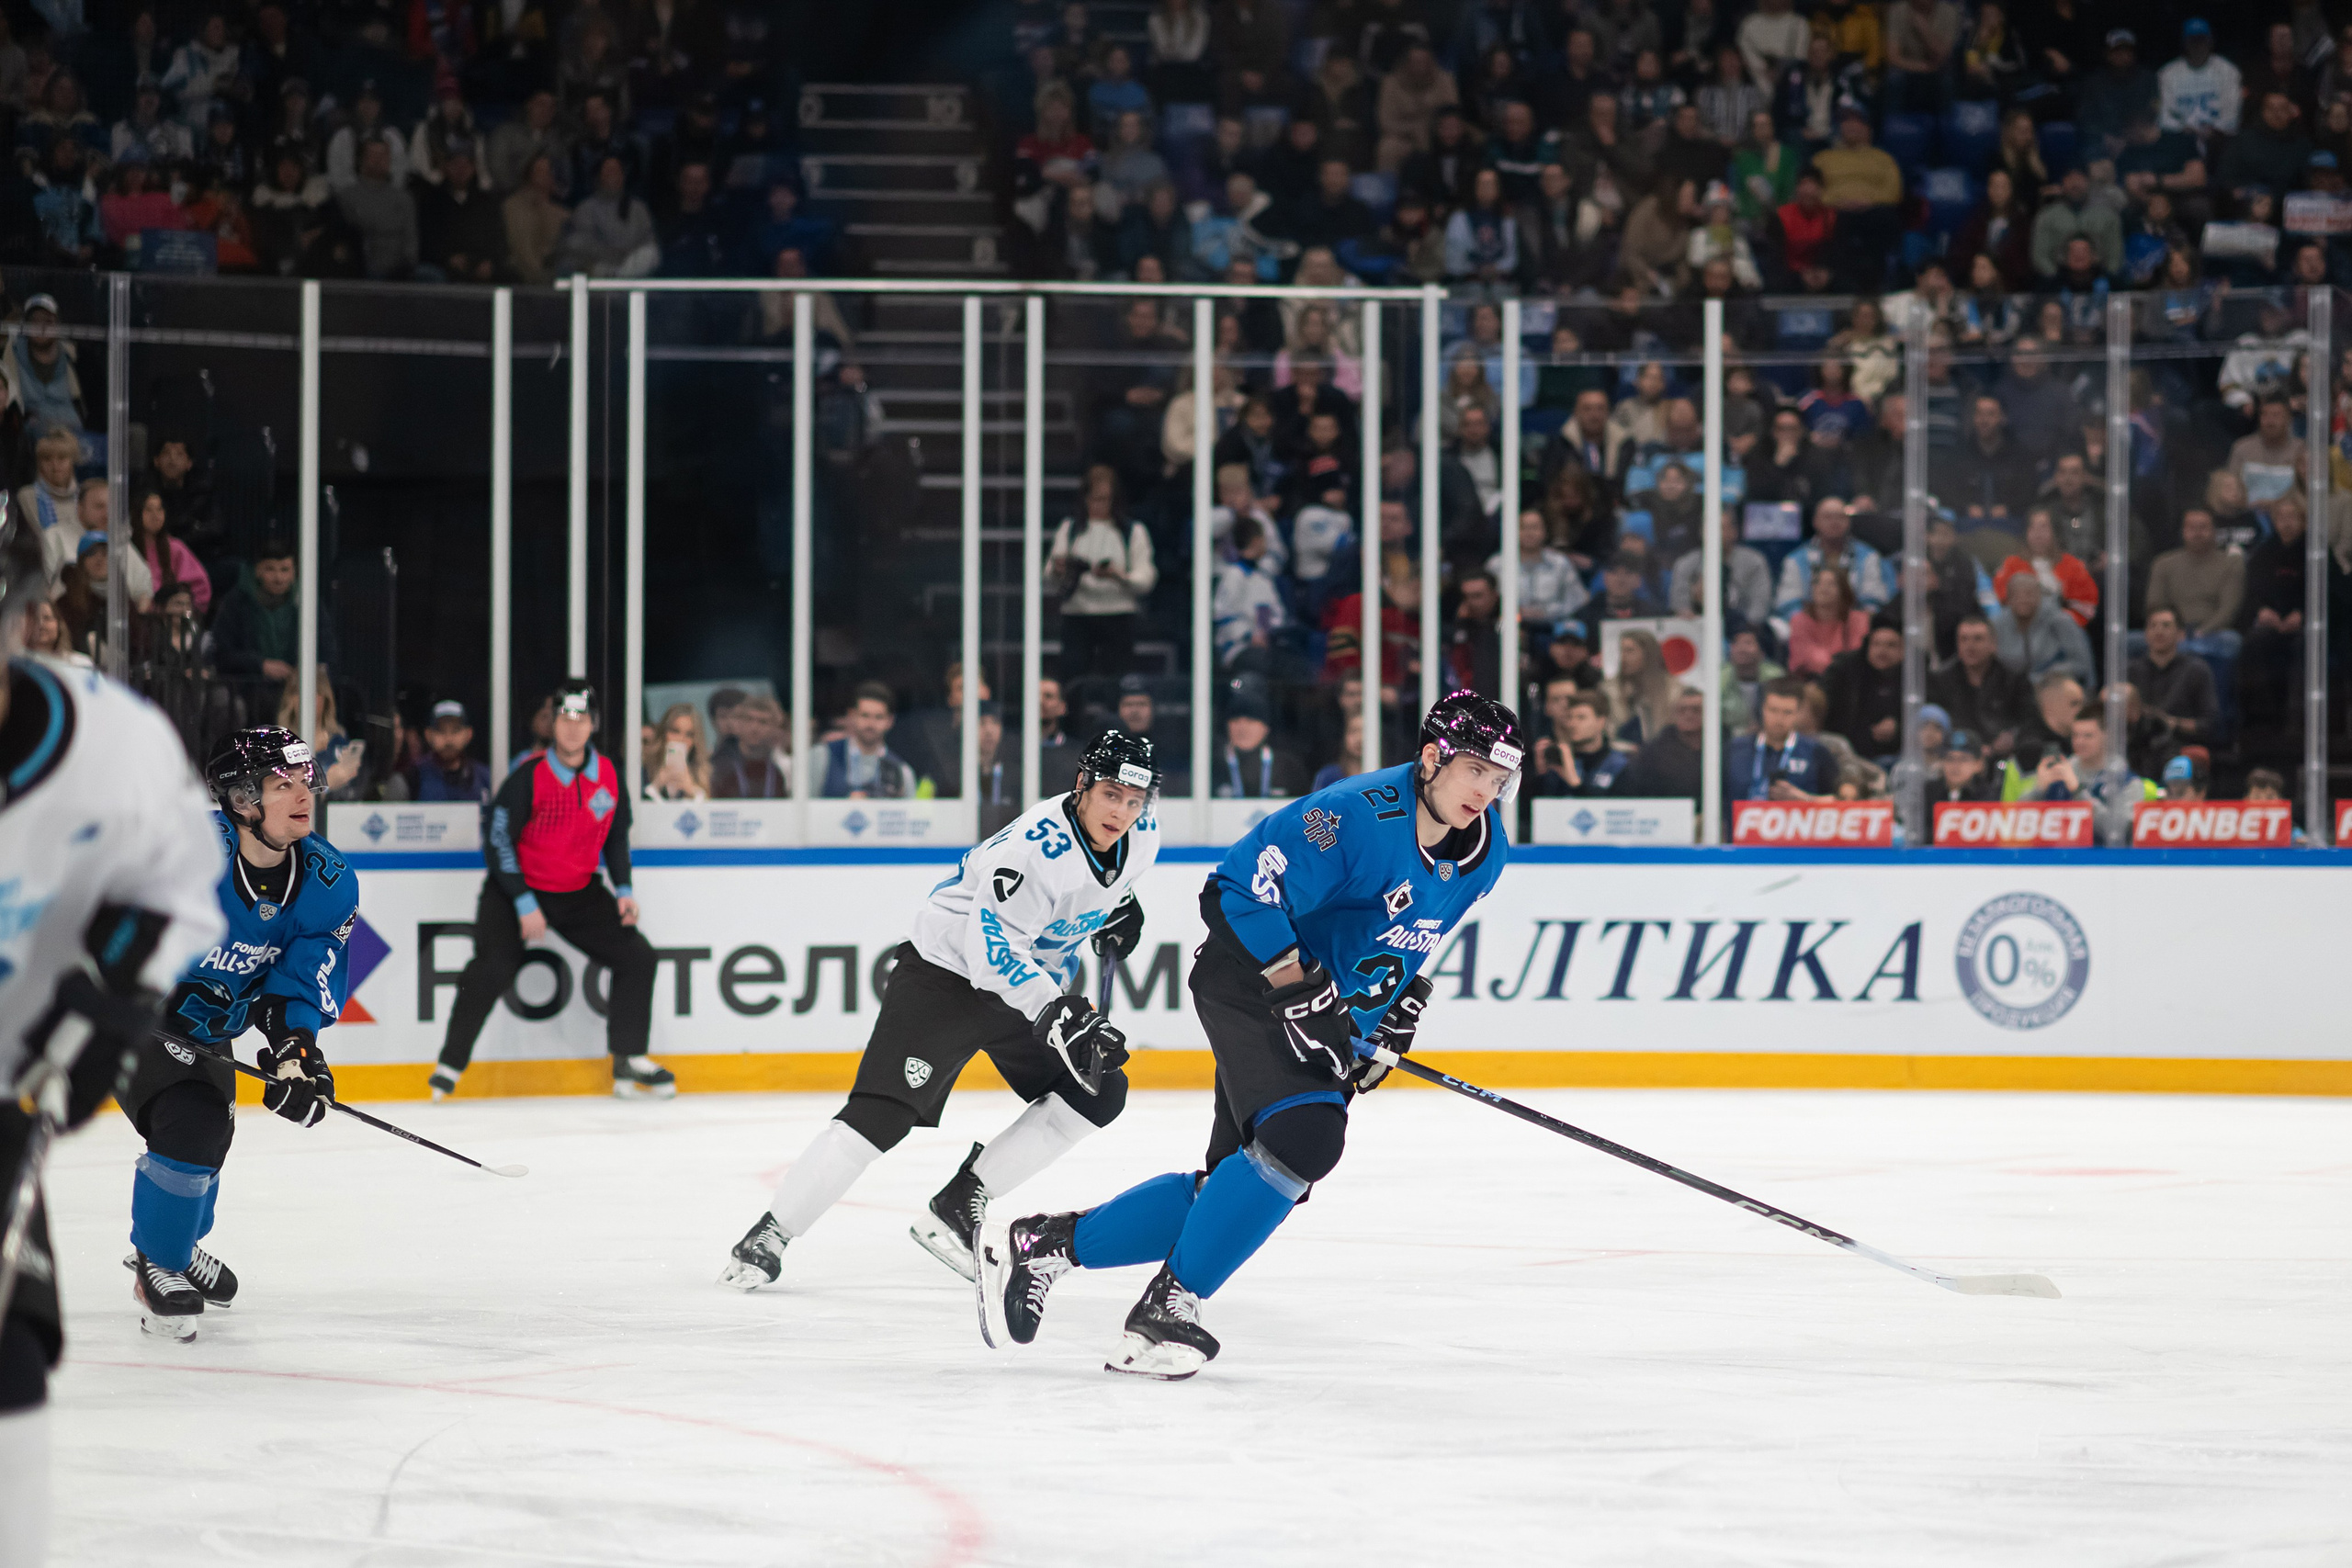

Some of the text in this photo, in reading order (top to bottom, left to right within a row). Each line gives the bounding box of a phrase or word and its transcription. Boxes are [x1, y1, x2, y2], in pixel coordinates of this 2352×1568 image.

[220, 771, 237, 779] CCM
[1361, 784, 1408, 822] 21
[1025, 818, 1072, 860] 53
[1735, 808, 1891, 840] FONBET
[1936, 808, 2089, 841] FONBET
[2136, 808, 2289, 840] FONBET
[1424, 919, 1924, 1002] АЛТИКА
[277, 1041, 294, 1058] CCM
[1442, 1074, 1502, 1103] CCM
